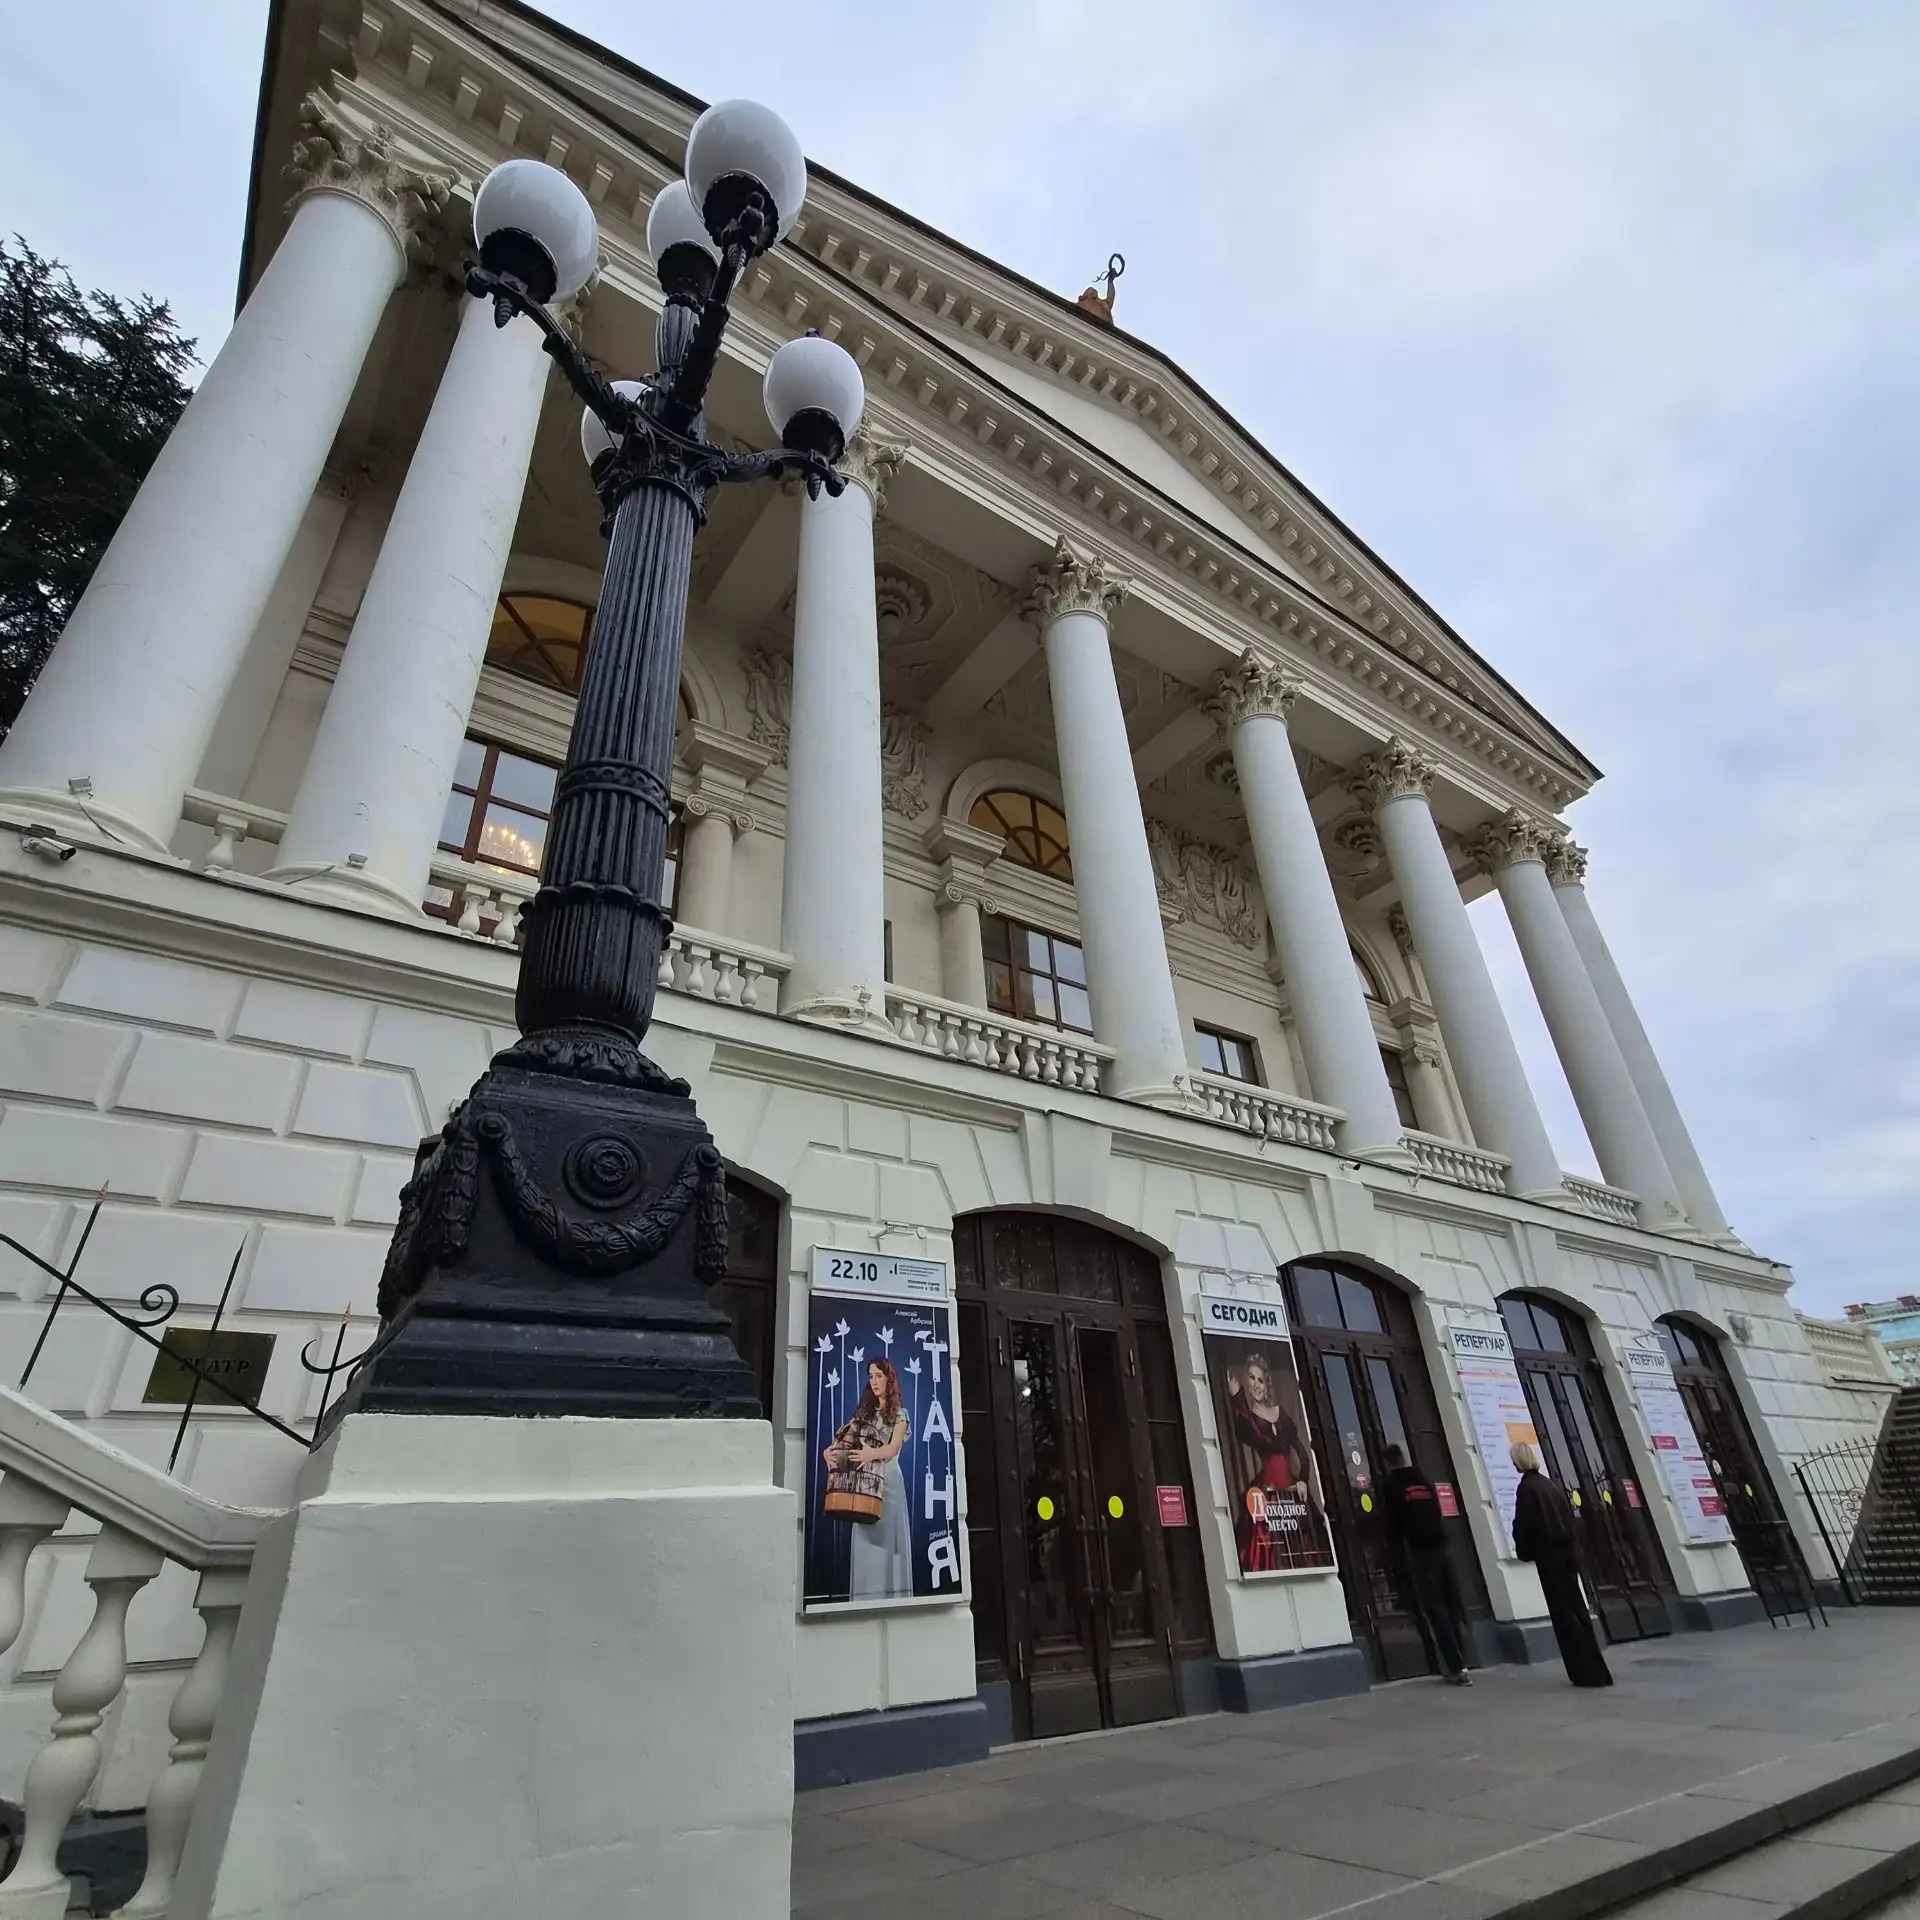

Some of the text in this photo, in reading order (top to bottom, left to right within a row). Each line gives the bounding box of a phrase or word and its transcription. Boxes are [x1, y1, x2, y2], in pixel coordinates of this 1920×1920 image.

[831, 1259, 878, 1281] 22.10
[1211, 1303, 1278, 1327] СЕГОДНЯ
[1454, 1333, 1505, 1351] РЕПЕРТУАР
[1628, 1353, 1665, 1367] РЕПЕРТУАР
[1268, 1519, 1299, 1532] МЕСТО
